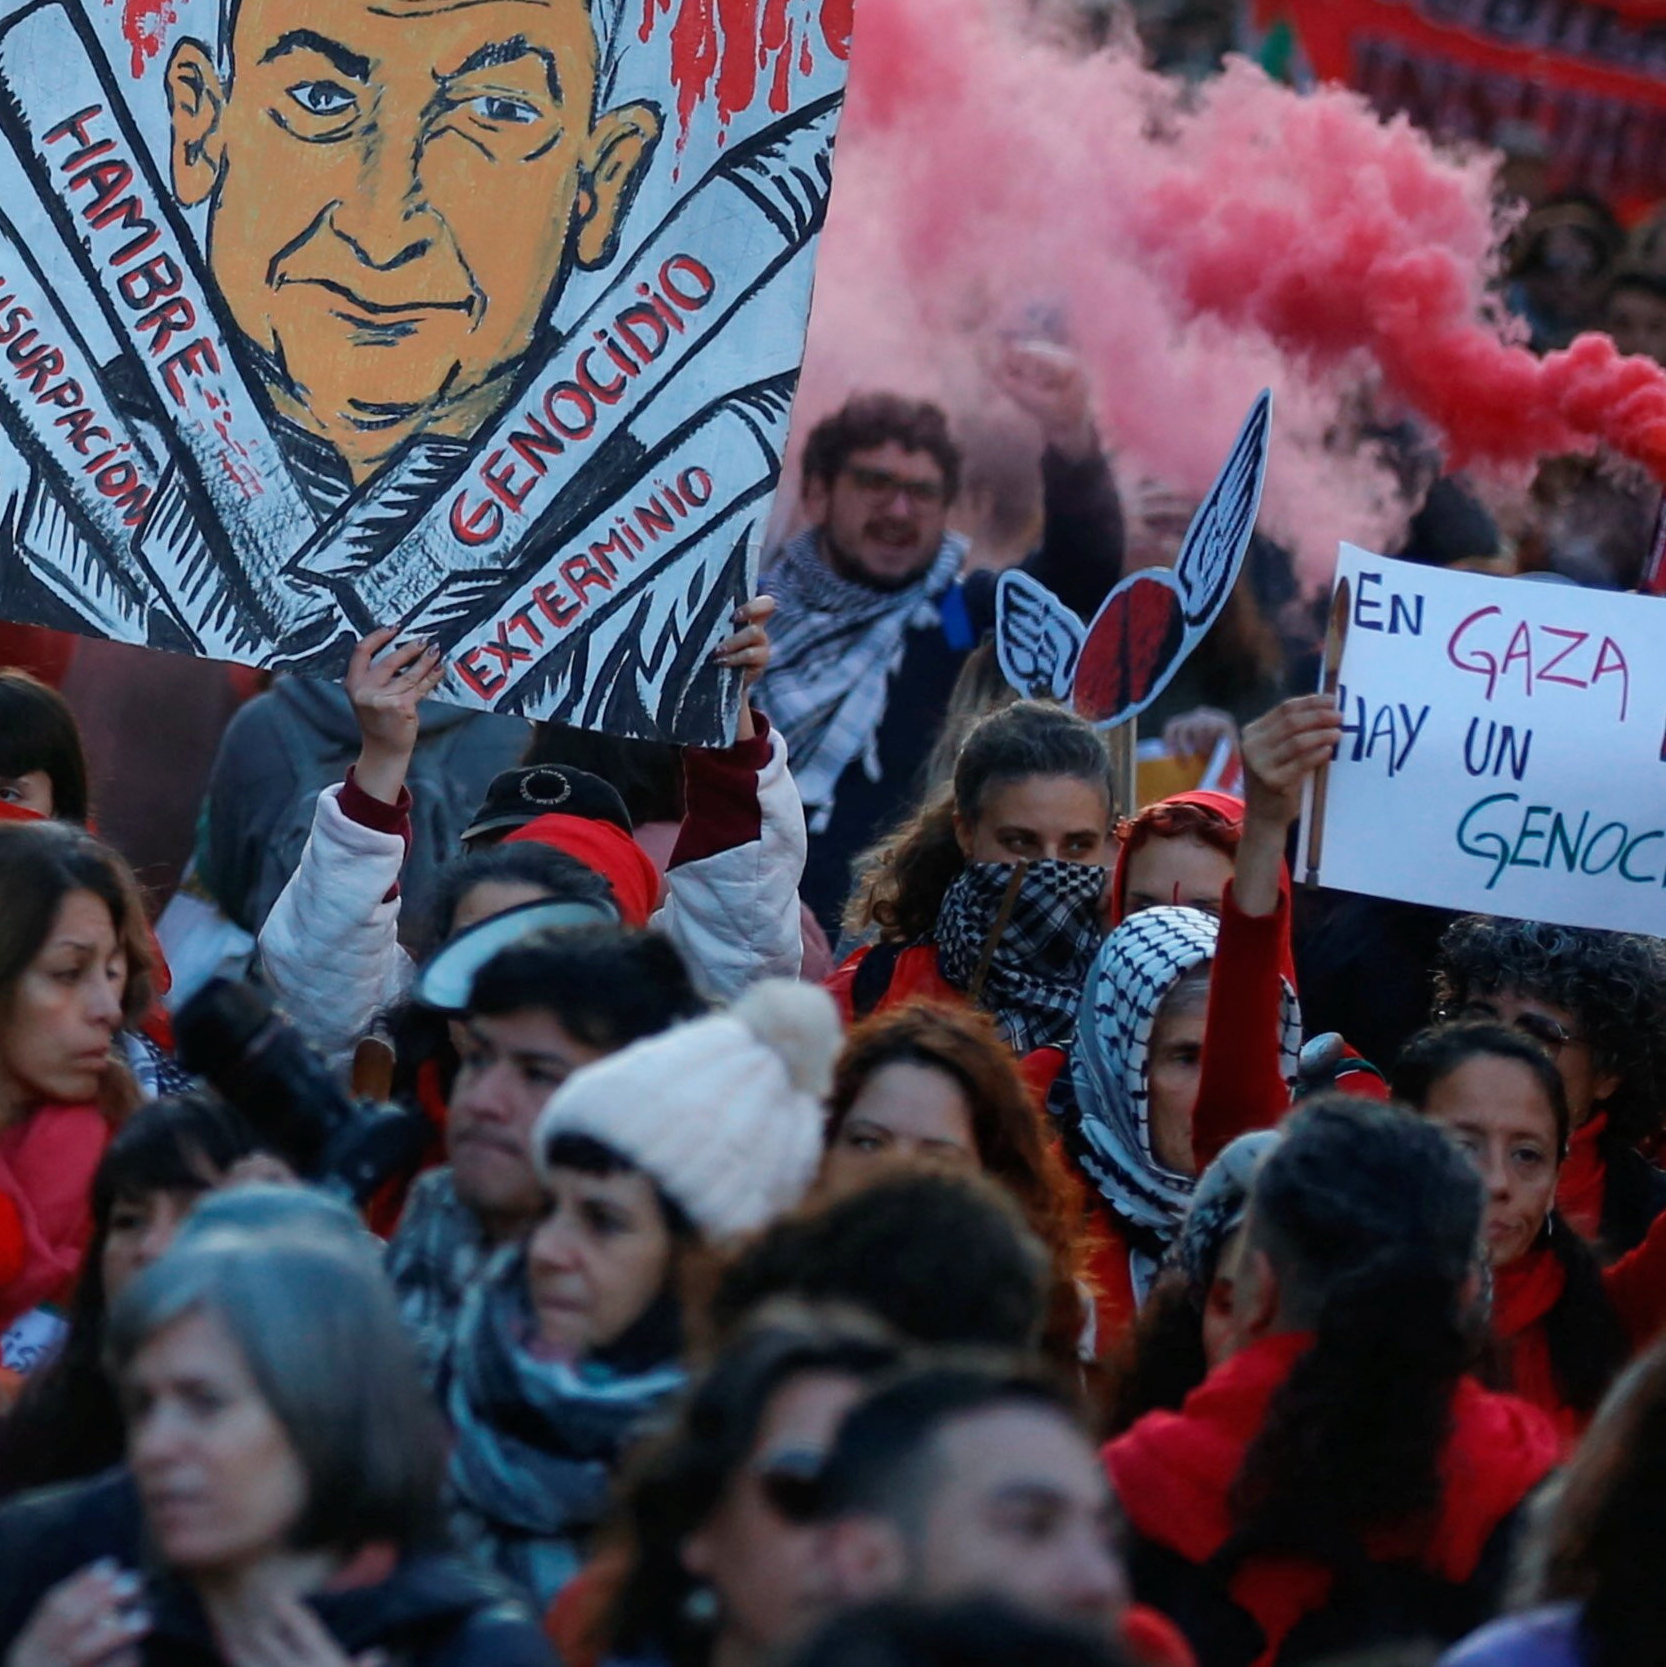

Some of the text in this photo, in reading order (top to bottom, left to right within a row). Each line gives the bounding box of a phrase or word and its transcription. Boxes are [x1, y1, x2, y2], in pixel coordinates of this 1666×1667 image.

[41, 103, 222, 409] HAMBRE
[454, 465, 714, 701] EXTERMINIO
[1353, 571, 1630, 722] EN GAZA
[1331, 684, 1533, 781] HAY UN
[1455, 792, 1665, 890] GENOC
